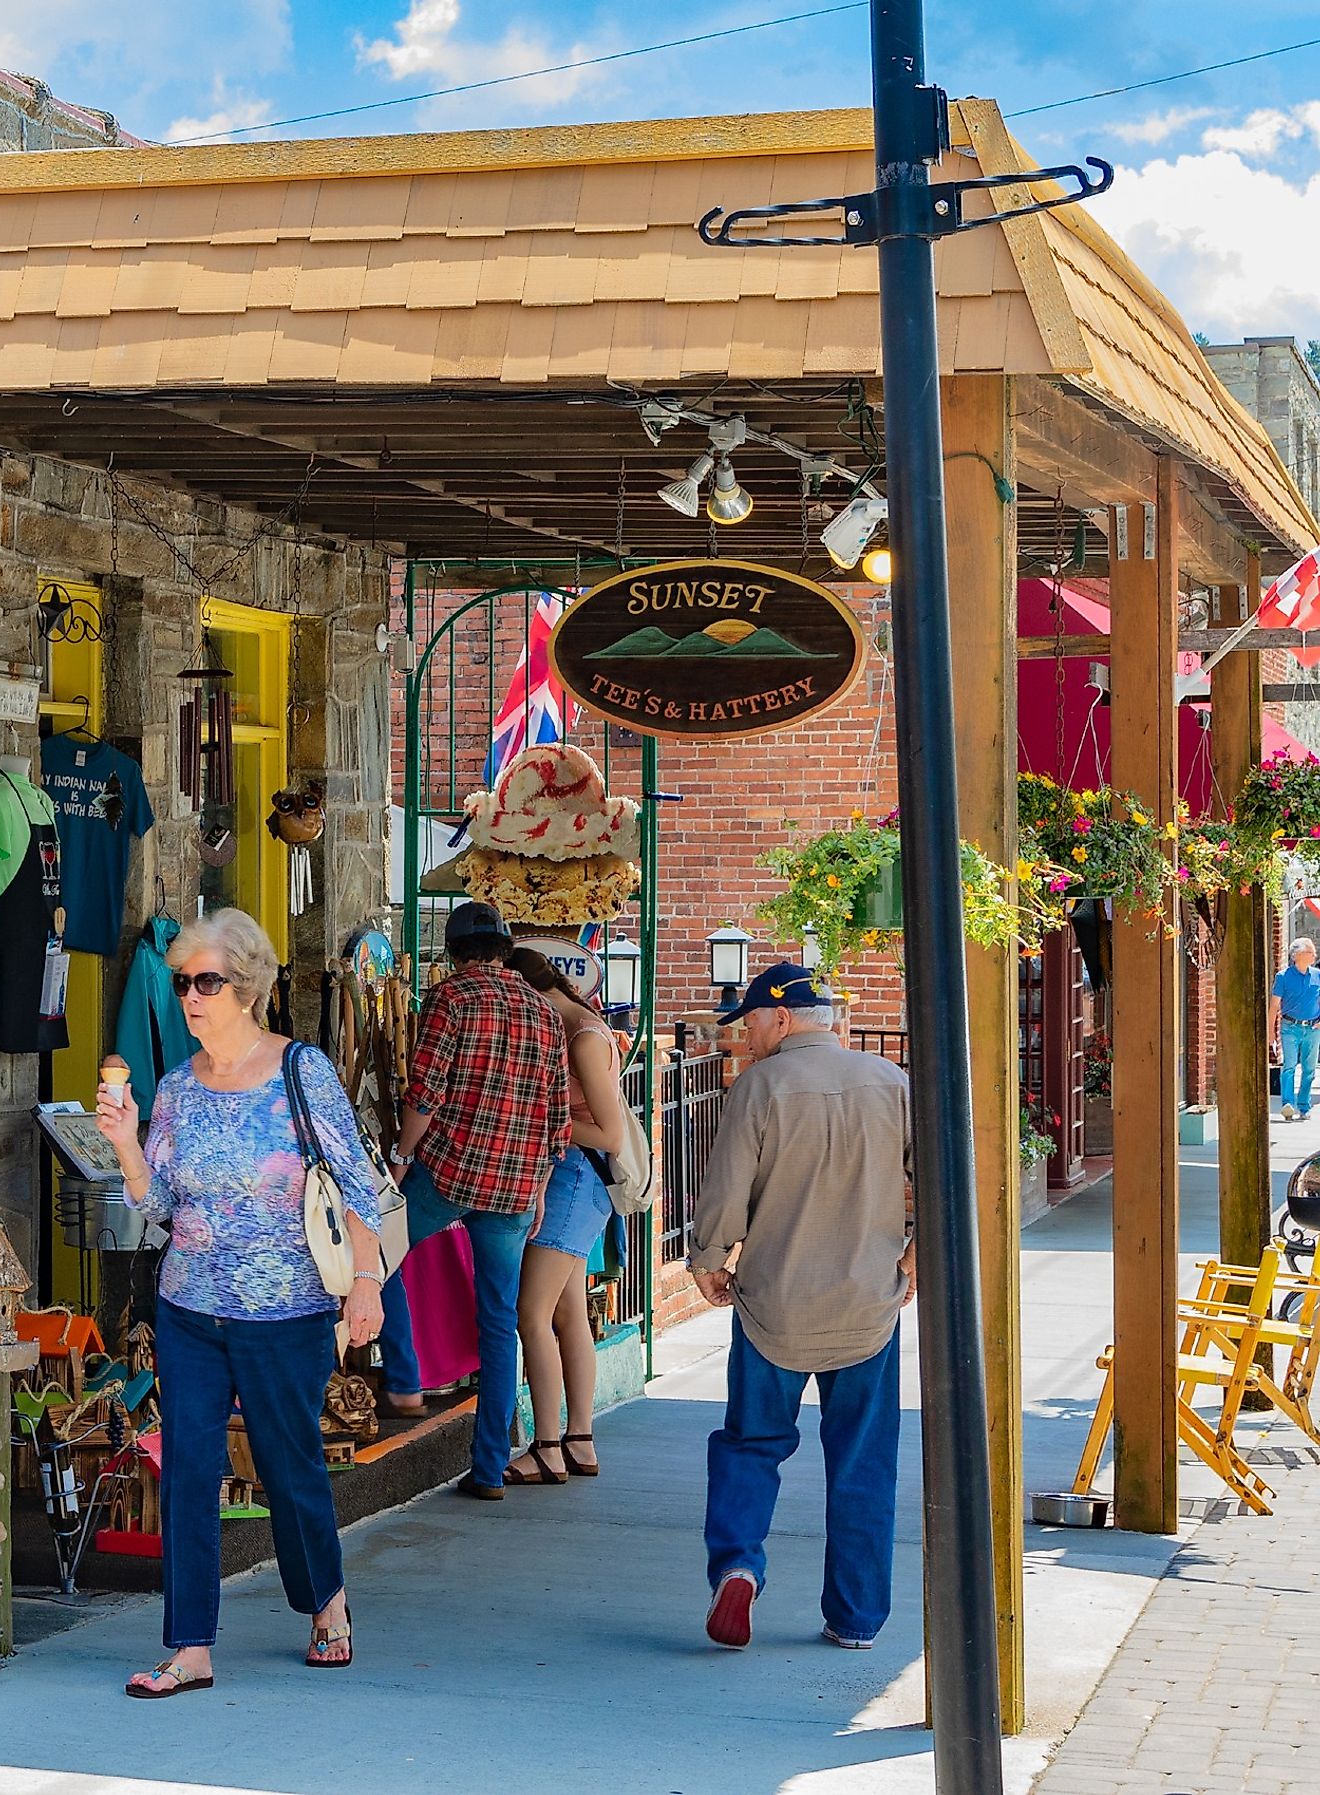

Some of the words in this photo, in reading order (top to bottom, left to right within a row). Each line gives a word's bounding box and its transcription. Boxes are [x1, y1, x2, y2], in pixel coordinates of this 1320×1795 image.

[627, 581, 776, 615] SUNSET
[589, 673, 663, 715] TEE'S
[664, 701, 683, 720] &
[689, 675, 817, 721] HATTERY
[54, 775, 86, 790] INDIAN
[71, 790, 79, 801] IS
[64, 802, 86, 817] WITH
